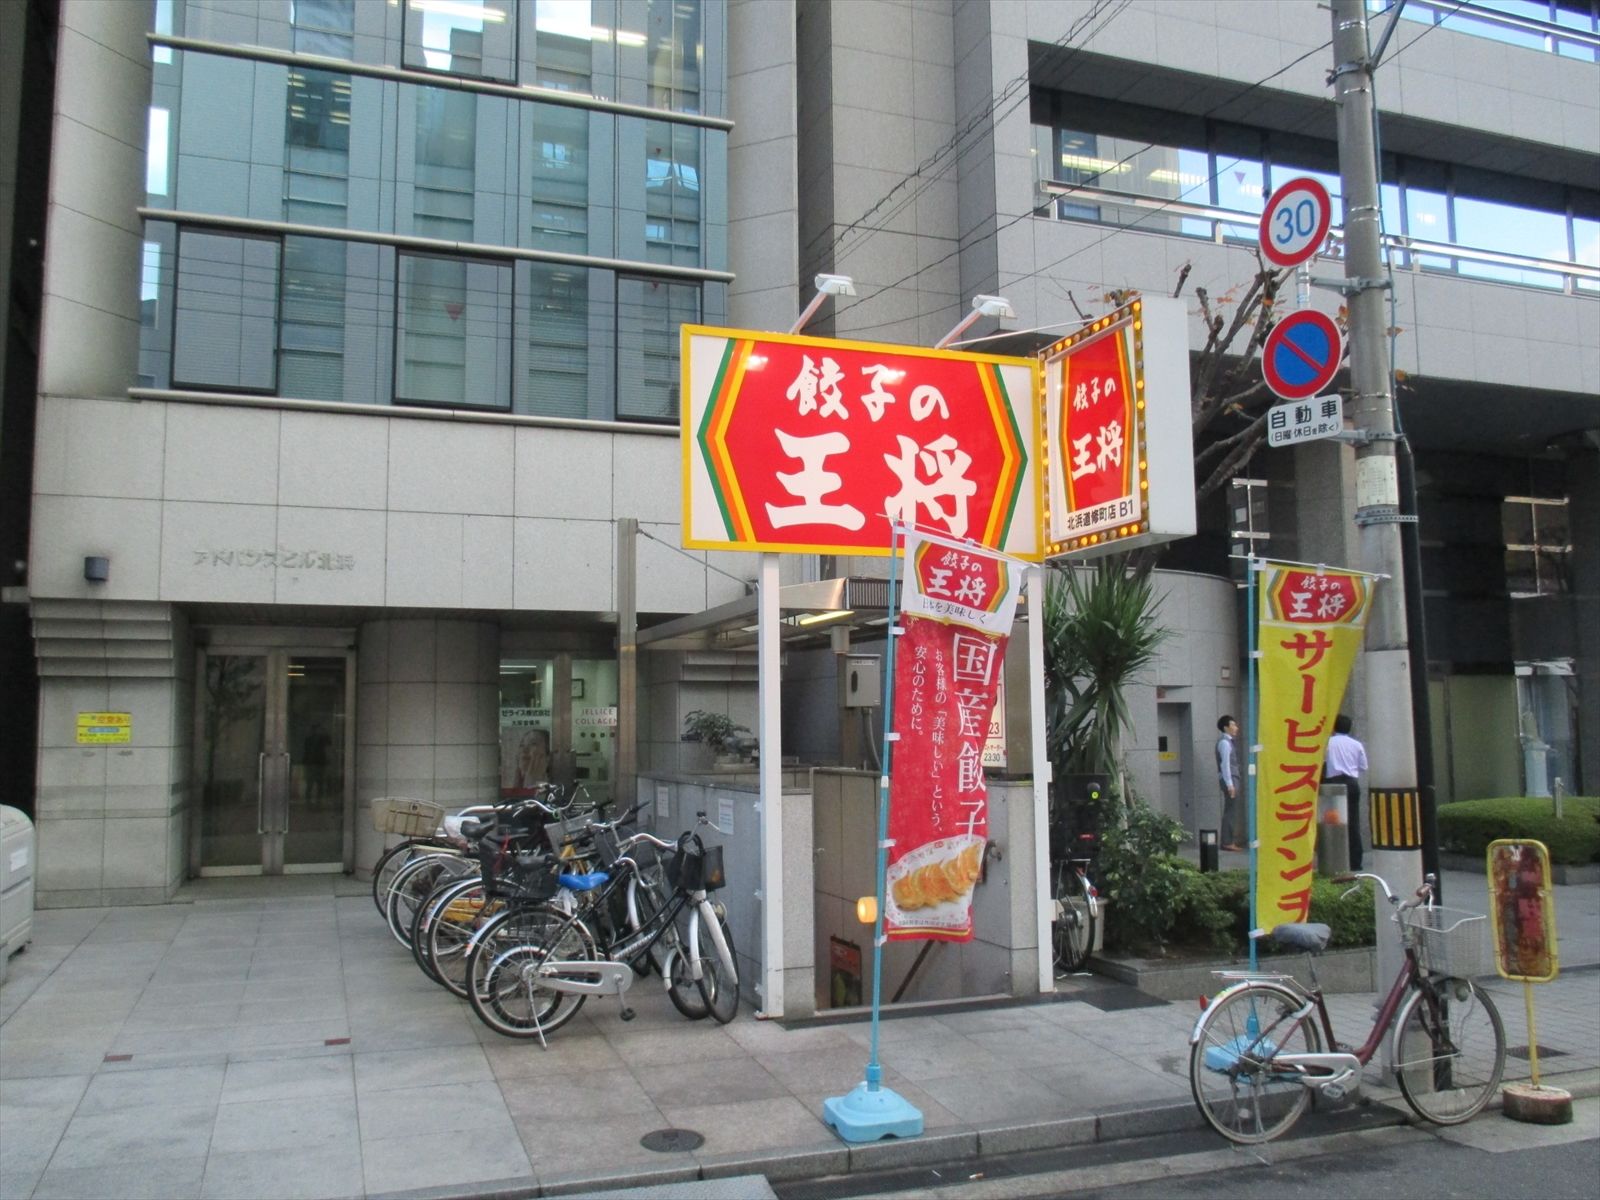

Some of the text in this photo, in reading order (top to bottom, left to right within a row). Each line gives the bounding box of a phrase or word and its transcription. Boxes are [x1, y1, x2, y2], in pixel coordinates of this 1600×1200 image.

[1275, 198, 1315, 244] 30
[786, 355, 950, 422] 餃子の
[1072, 374, 1117, 412] 餃子の
[1271, 400, 1338, 429] 自動車
[1072, 420, 1124, 481] 王将
[764, 427, 978, 539] 王将
[1067, 499, 1134, 531] 北浜道修町店 B1
[940, 550, 982, 572] 餃子の
[926, 566, 987, 607] 王将
[1300, 575, 1341, 592] 餃子の
[1288, 590, 1347, 619] 王将
[910, 646, 927, 736] 安心のために。
[581, 708, 615, 716] JELLICE
[953, 632, 997, 841] 国産餃子
[1273, 630, 1334, 923] サービスランチ
